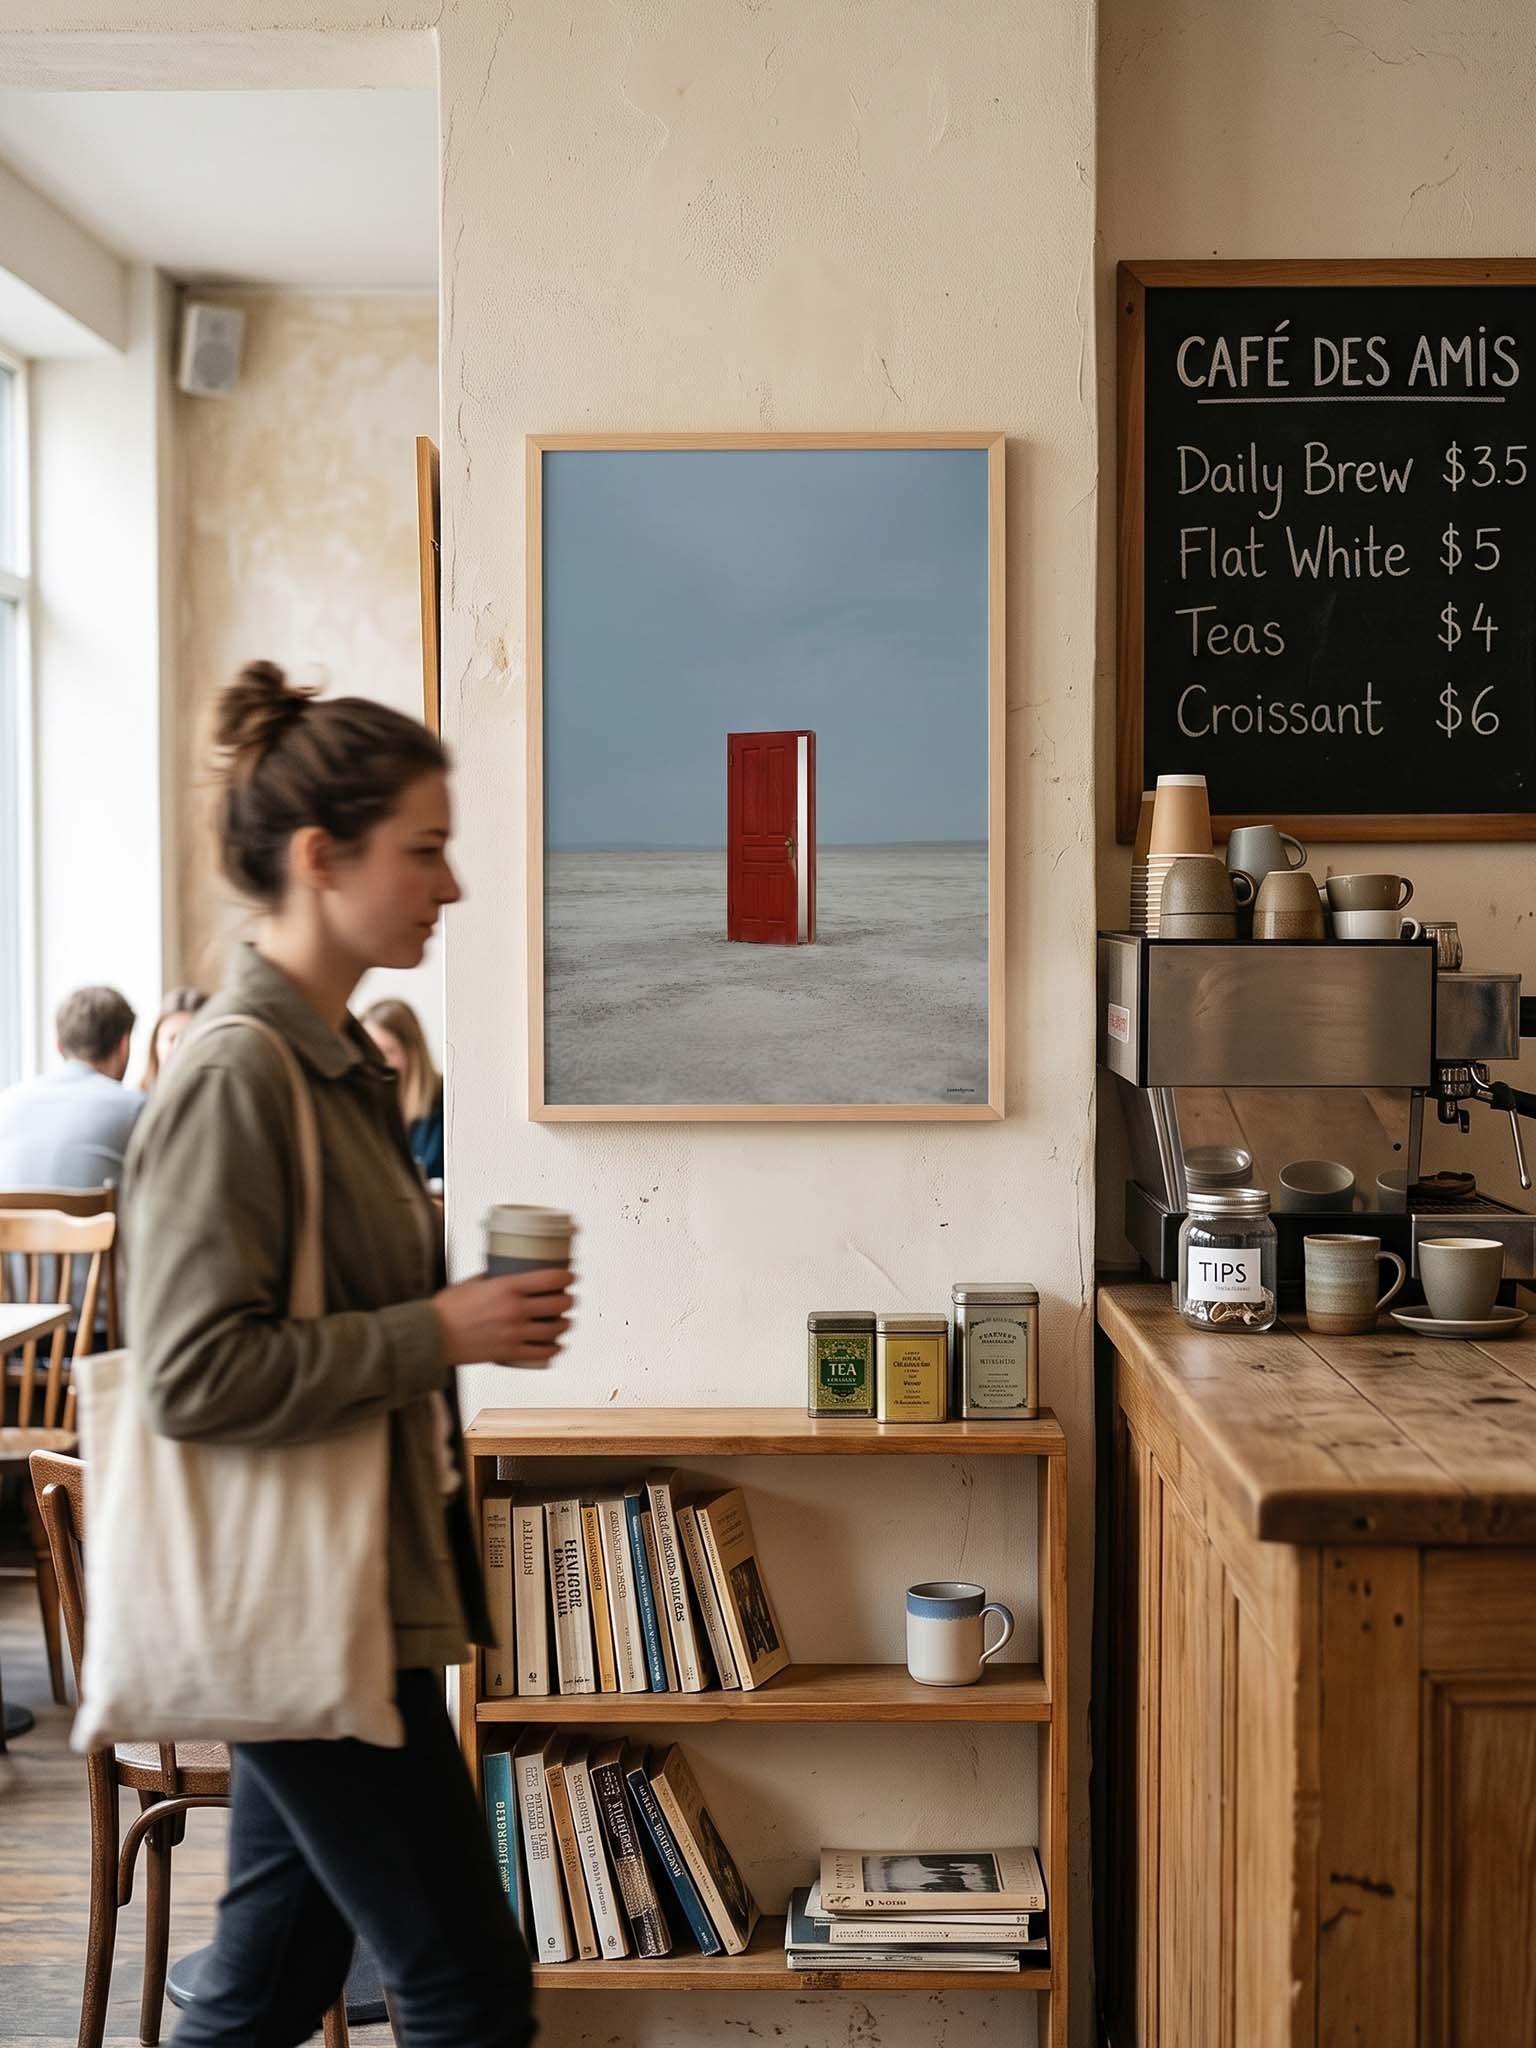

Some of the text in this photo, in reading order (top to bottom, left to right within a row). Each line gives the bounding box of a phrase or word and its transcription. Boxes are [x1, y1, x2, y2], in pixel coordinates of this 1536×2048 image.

[1176, 319, 1290, 388] CAFÉ
[1313, 335, 1390, 388] DES
[1176, 442, 1283, 520] Daily
[1303, 441, 1414, 495] Brew
[1179, 526, 1267, 580] Flat
[1285, 524, 1411, 579] White
[1174, 605, 1286, 657] Teas
[1177, 681, 1384, 738] Croissant
[1198, 1261, 1247, 1284] TIPS
[828, 1363, 857, 1376] TEA
